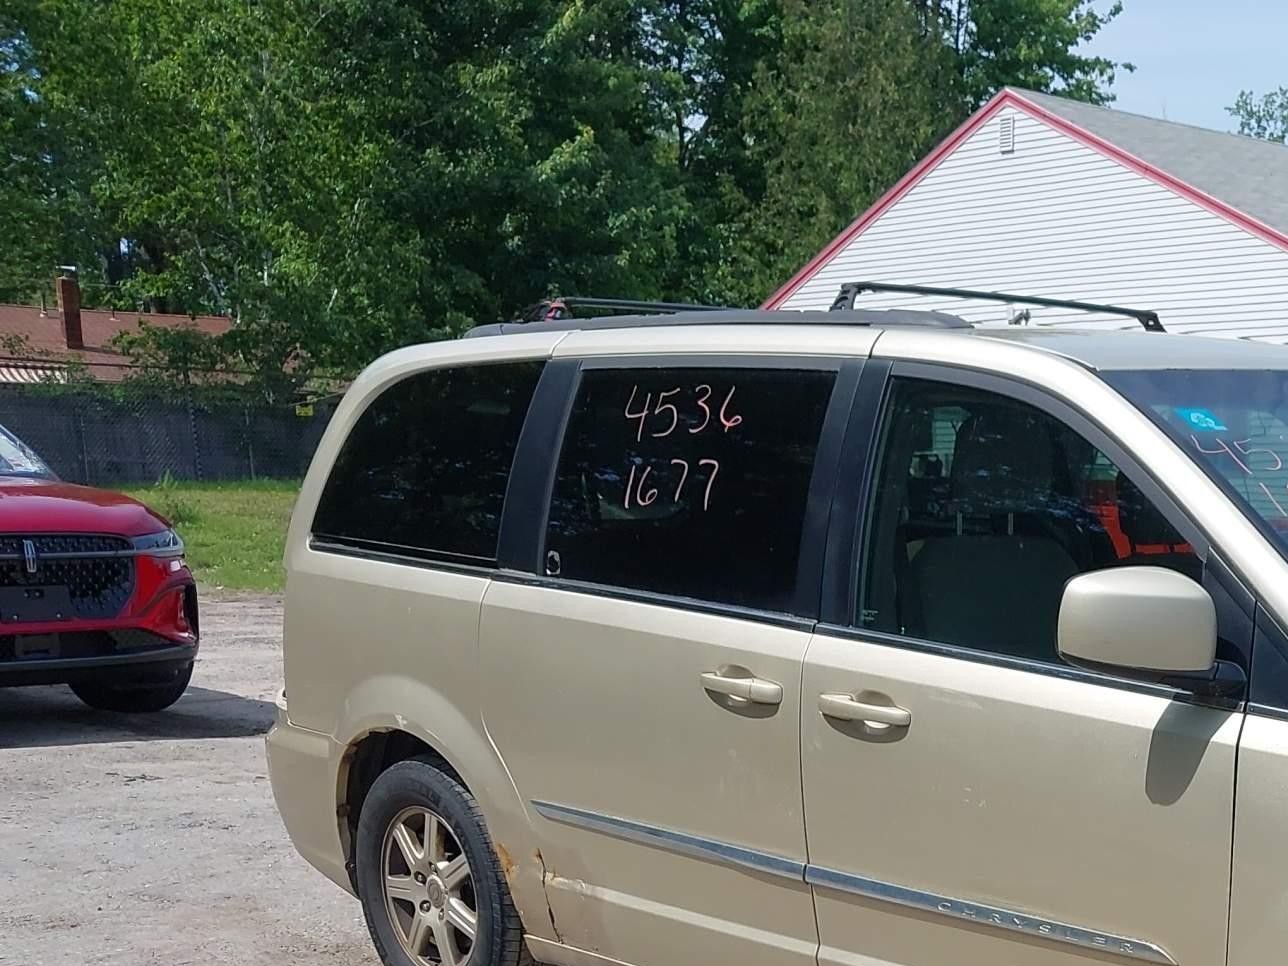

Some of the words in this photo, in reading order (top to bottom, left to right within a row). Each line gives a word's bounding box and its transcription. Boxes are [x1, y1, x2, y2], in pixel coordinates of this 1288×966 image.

[624, 384, 743, 443] 4536
[624, 459, 720, 512] 1677
[937, 902, 1135, 953] CHRYSLER
